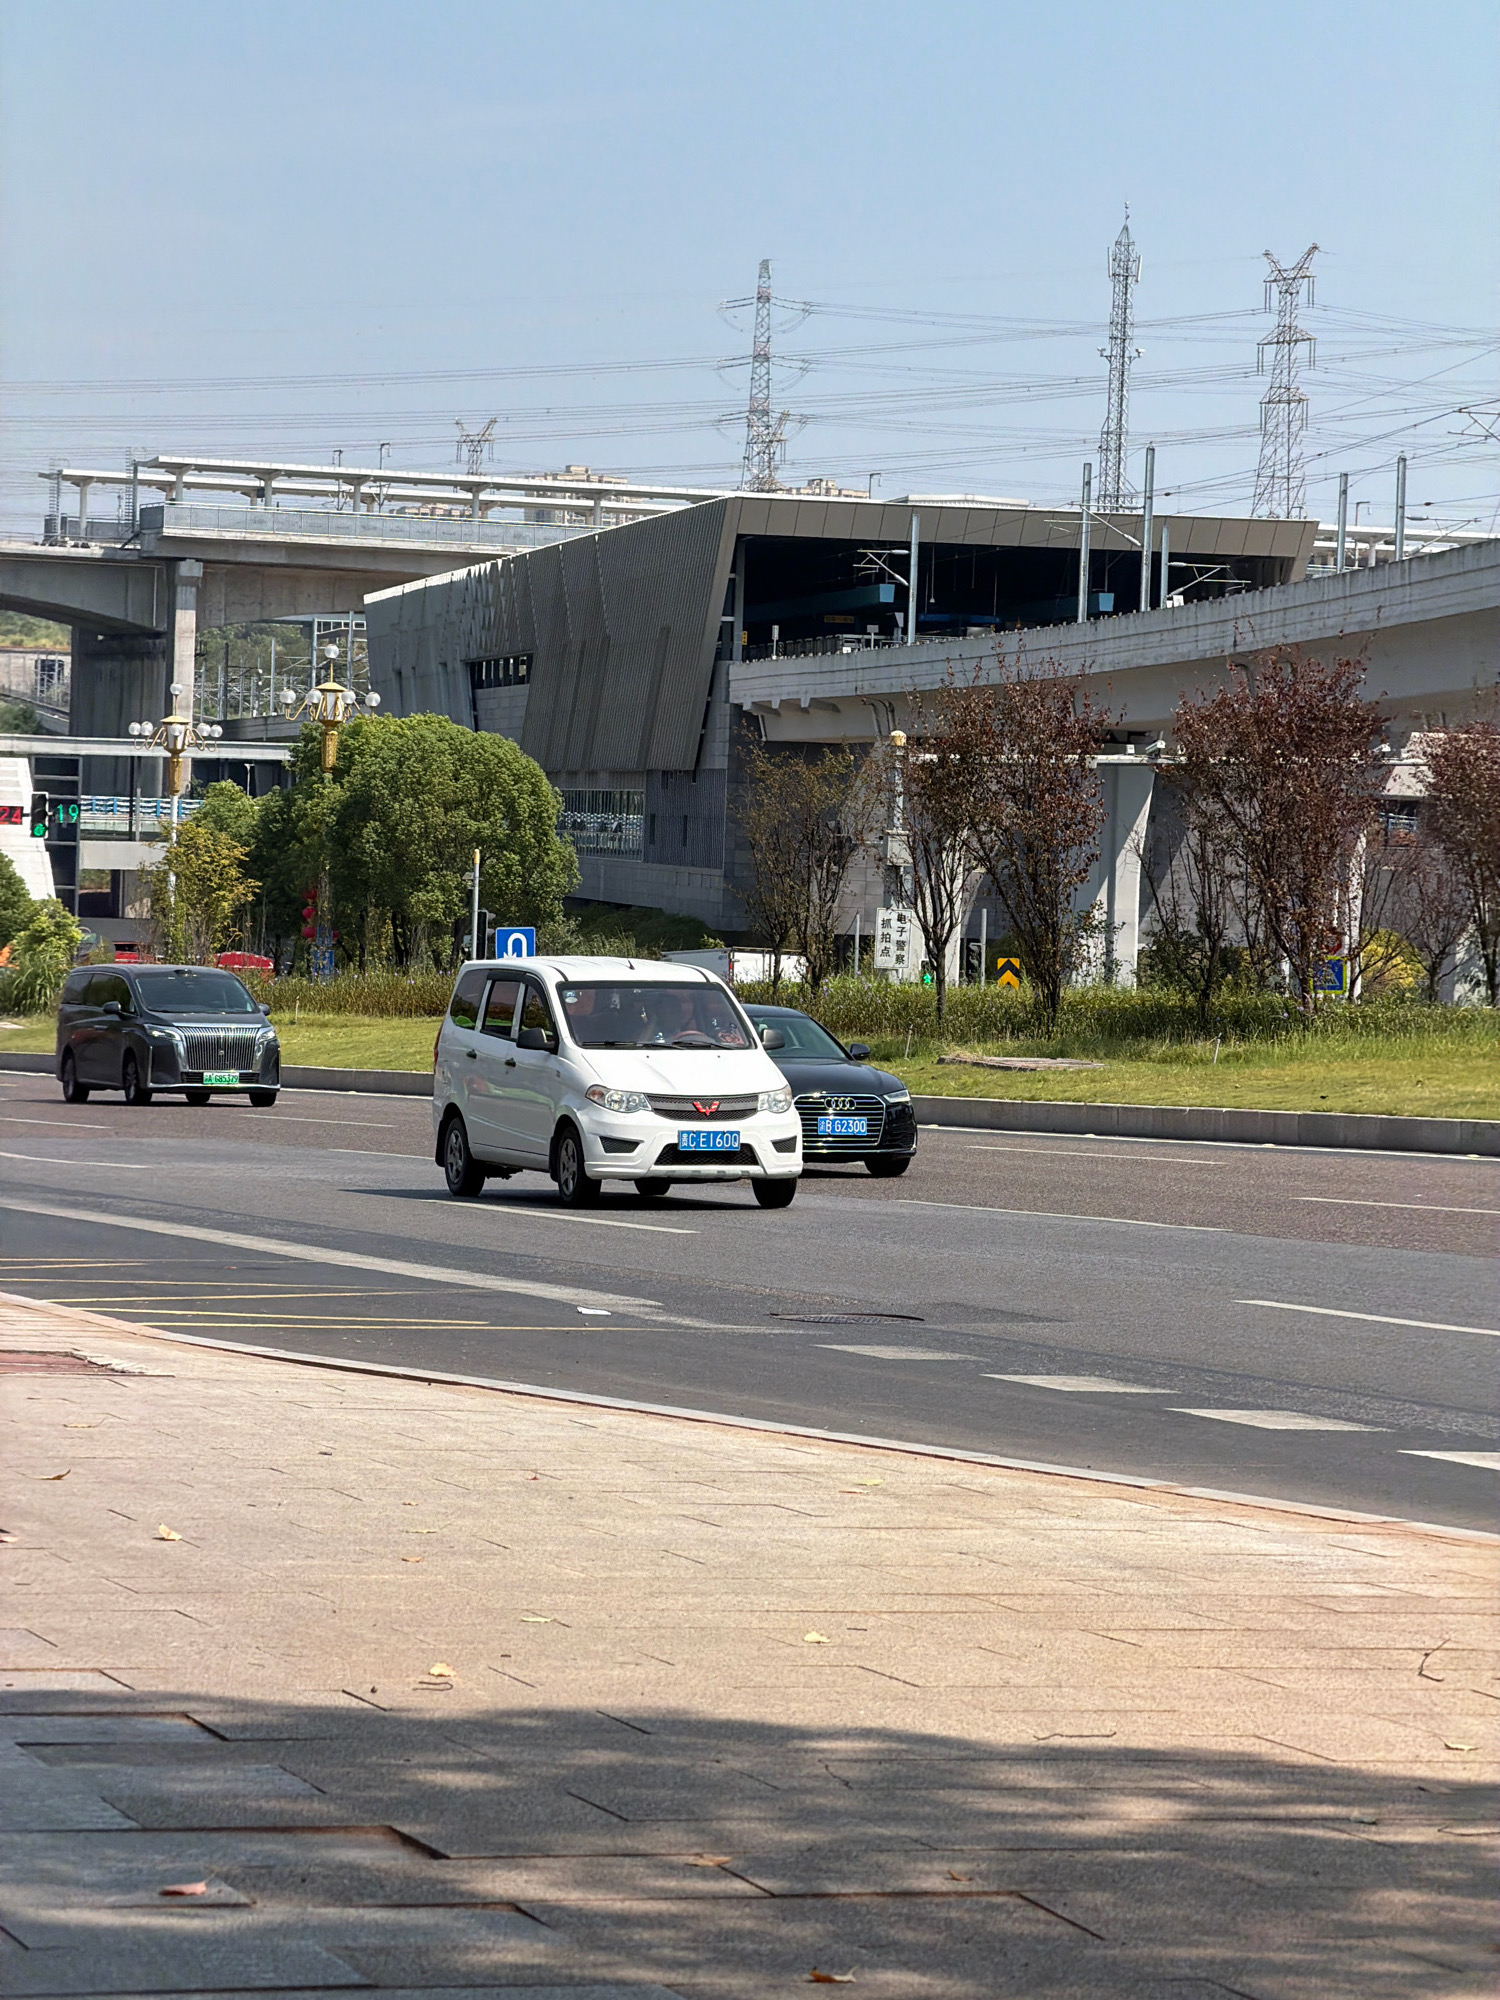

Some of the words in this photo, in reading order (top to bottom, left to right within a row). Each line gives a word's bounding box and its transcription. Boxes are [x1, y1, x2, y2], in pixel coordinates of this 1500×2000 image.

[57, 804, 79, 823] 19
[880, 917, 892, 957] 抓拍点
[895, 912, 907, 965] 电子警察
